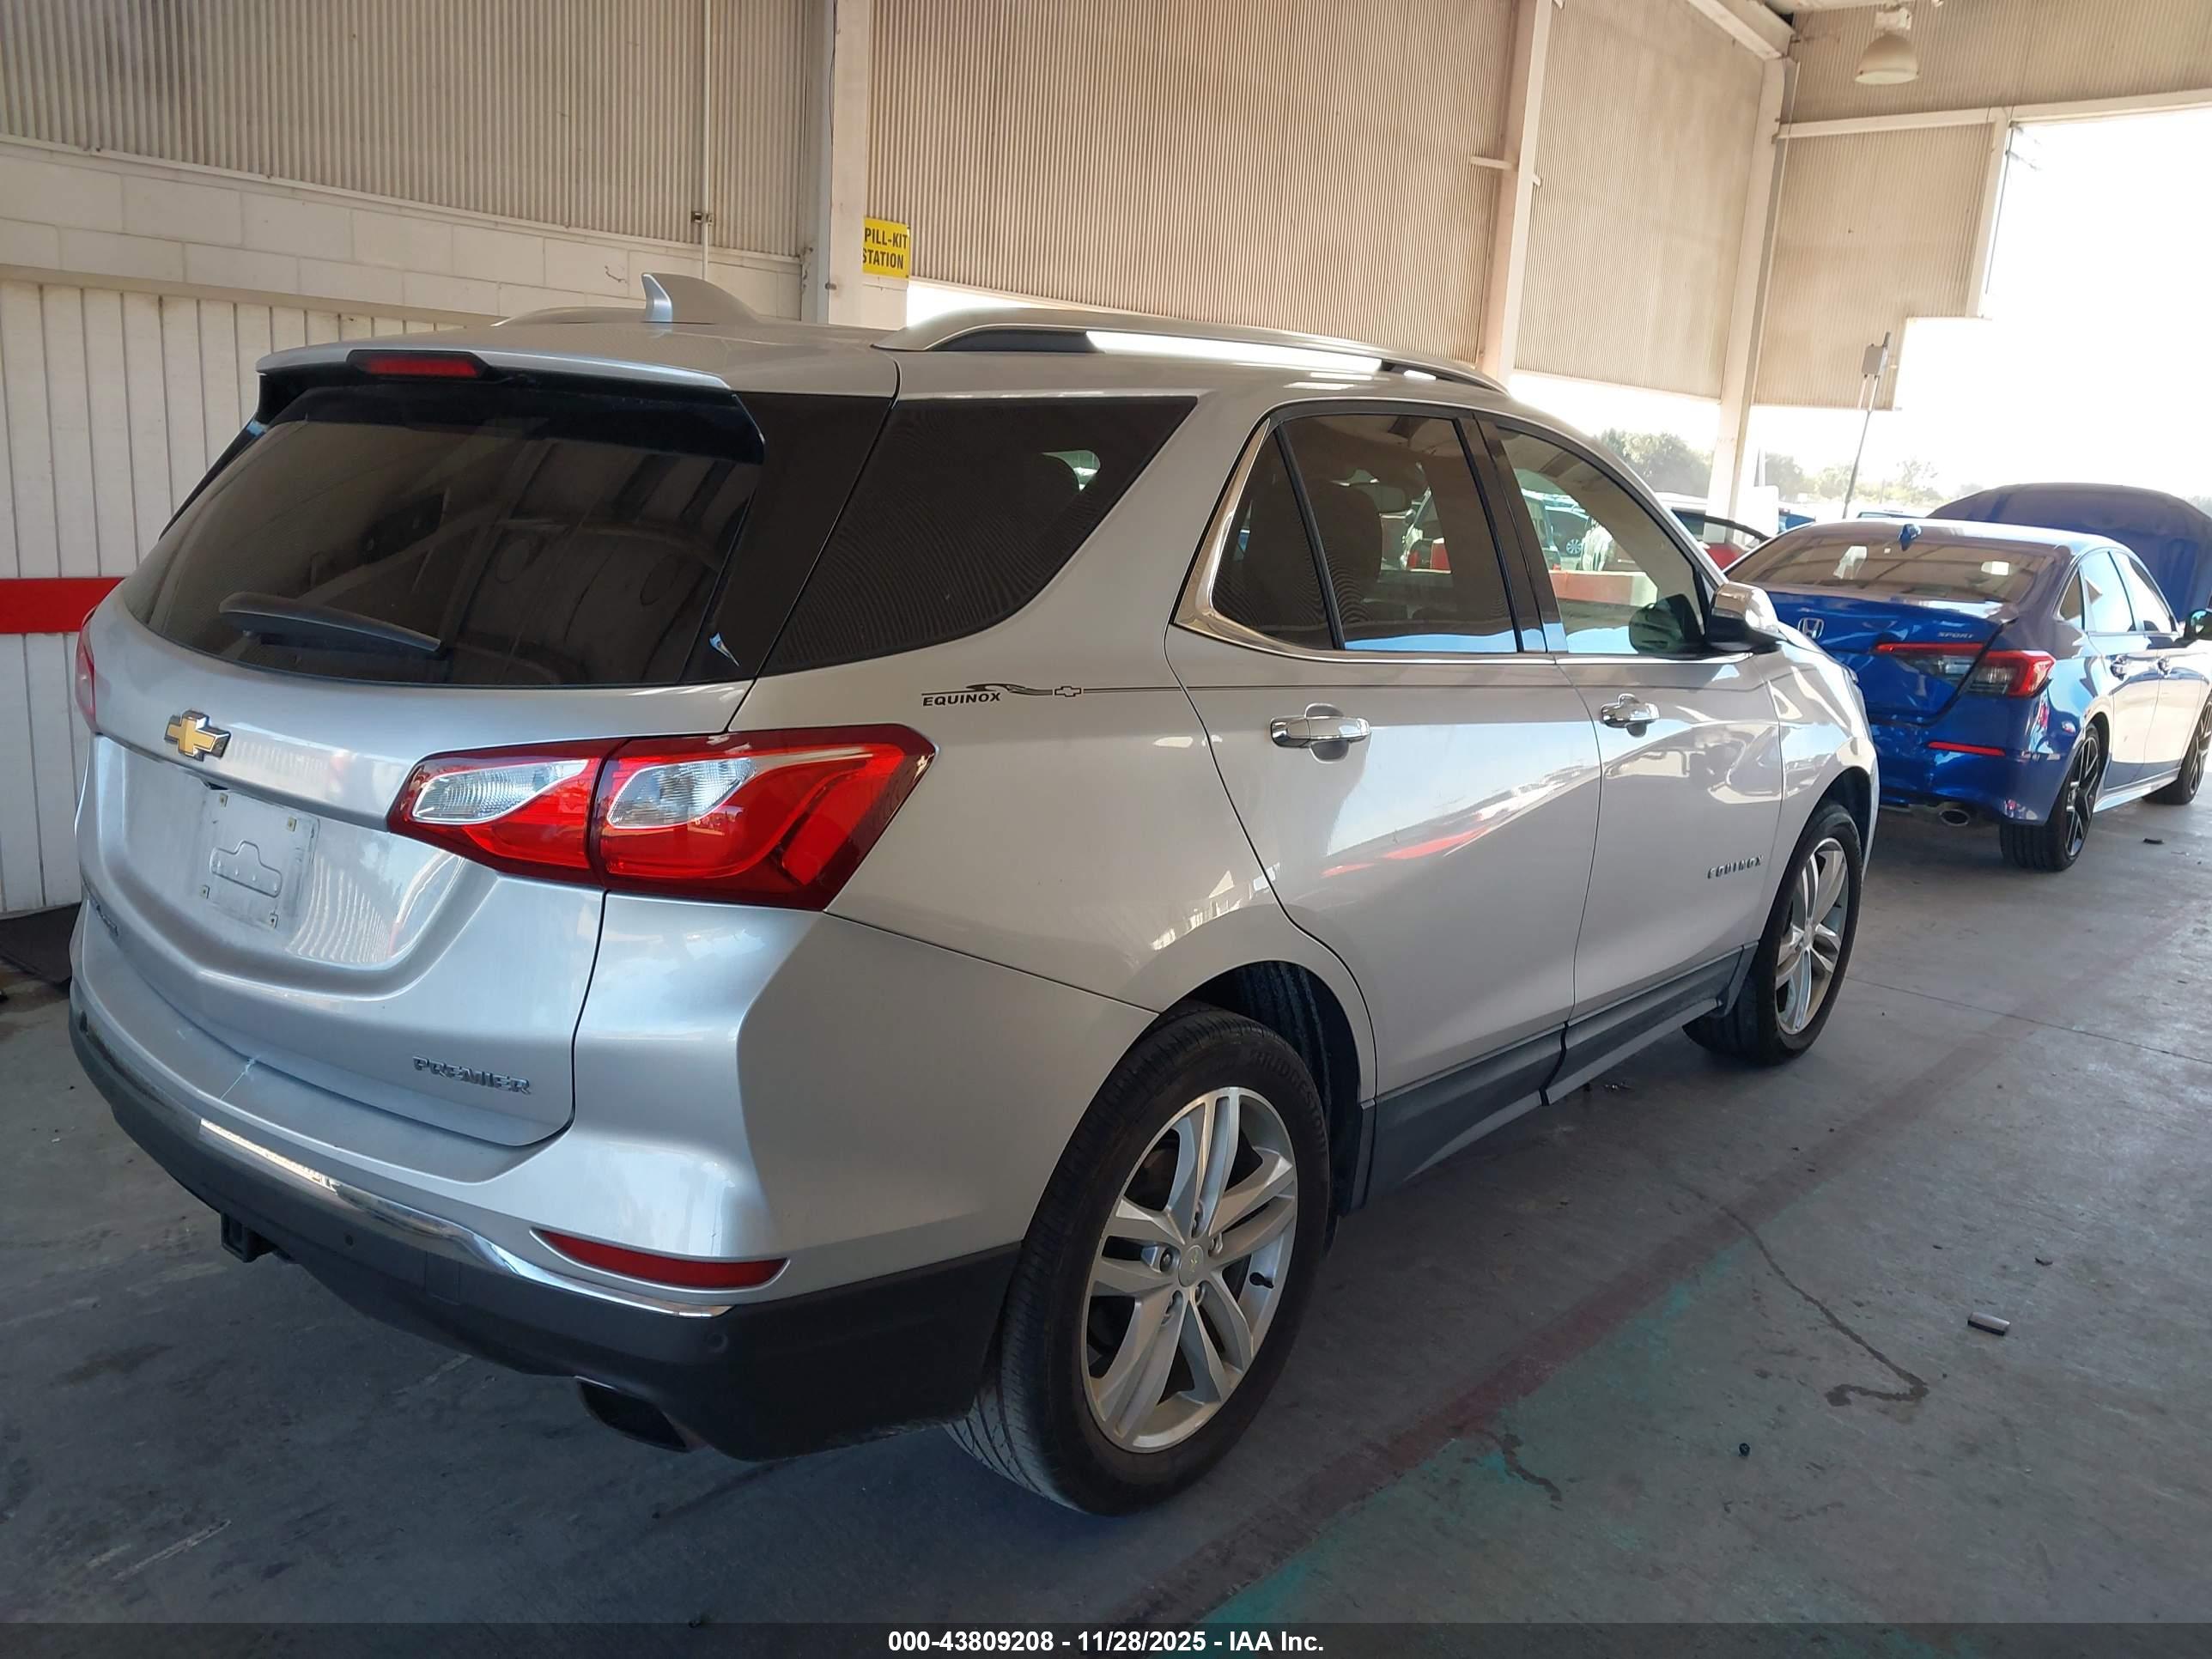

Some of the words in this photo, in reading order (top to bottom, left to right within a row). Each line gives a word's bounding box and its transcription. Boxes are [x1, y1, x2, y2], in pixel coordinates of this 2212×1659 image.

[865, 228, 908, 250] PILL-KIT
[922, 692, 1001, 707] EQUINOX
[412, 1055, 532, 1095] PREMIER
